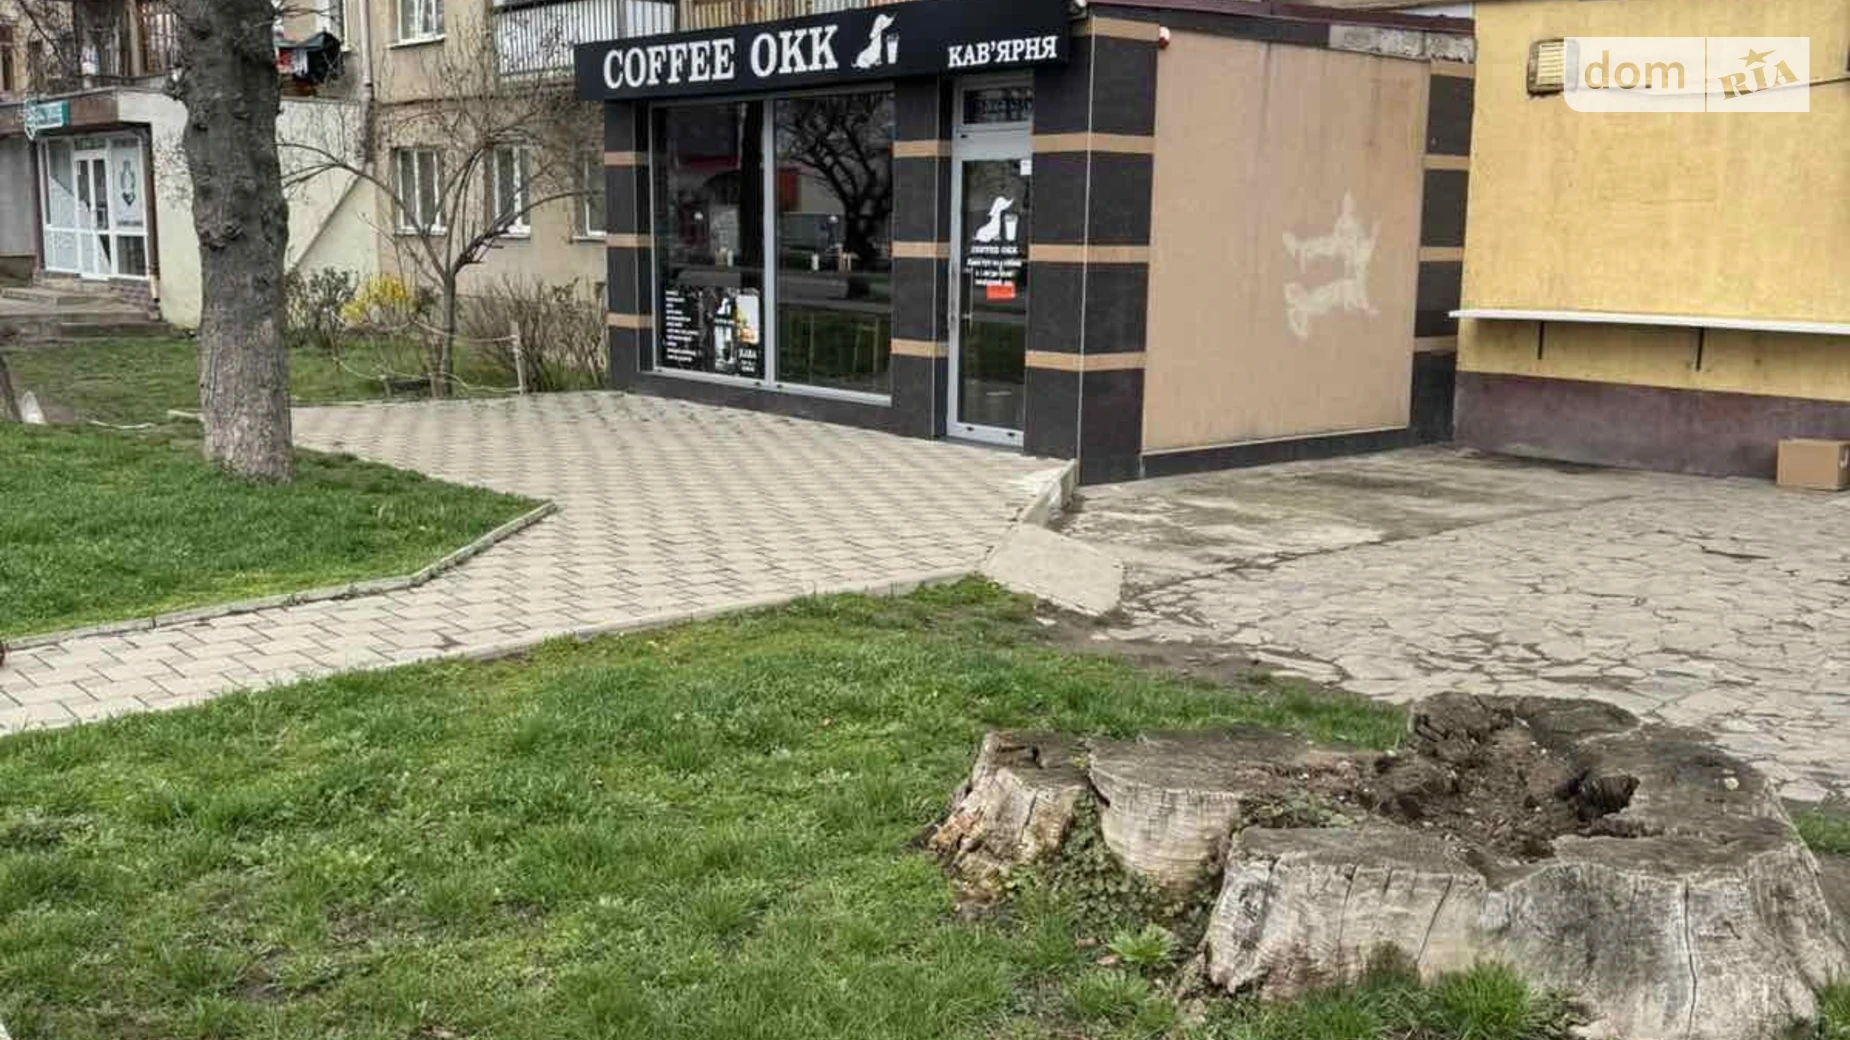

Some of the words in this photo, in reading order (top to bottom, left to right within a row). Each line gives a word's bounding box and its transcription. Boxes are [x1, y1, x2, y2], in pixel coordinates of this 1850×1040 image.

[603, 37, 735, 89] COFFEE
[750, 24, 839, 78] OKK
[947, 35, 1059, 68] КАВ’ЯРНЯ
